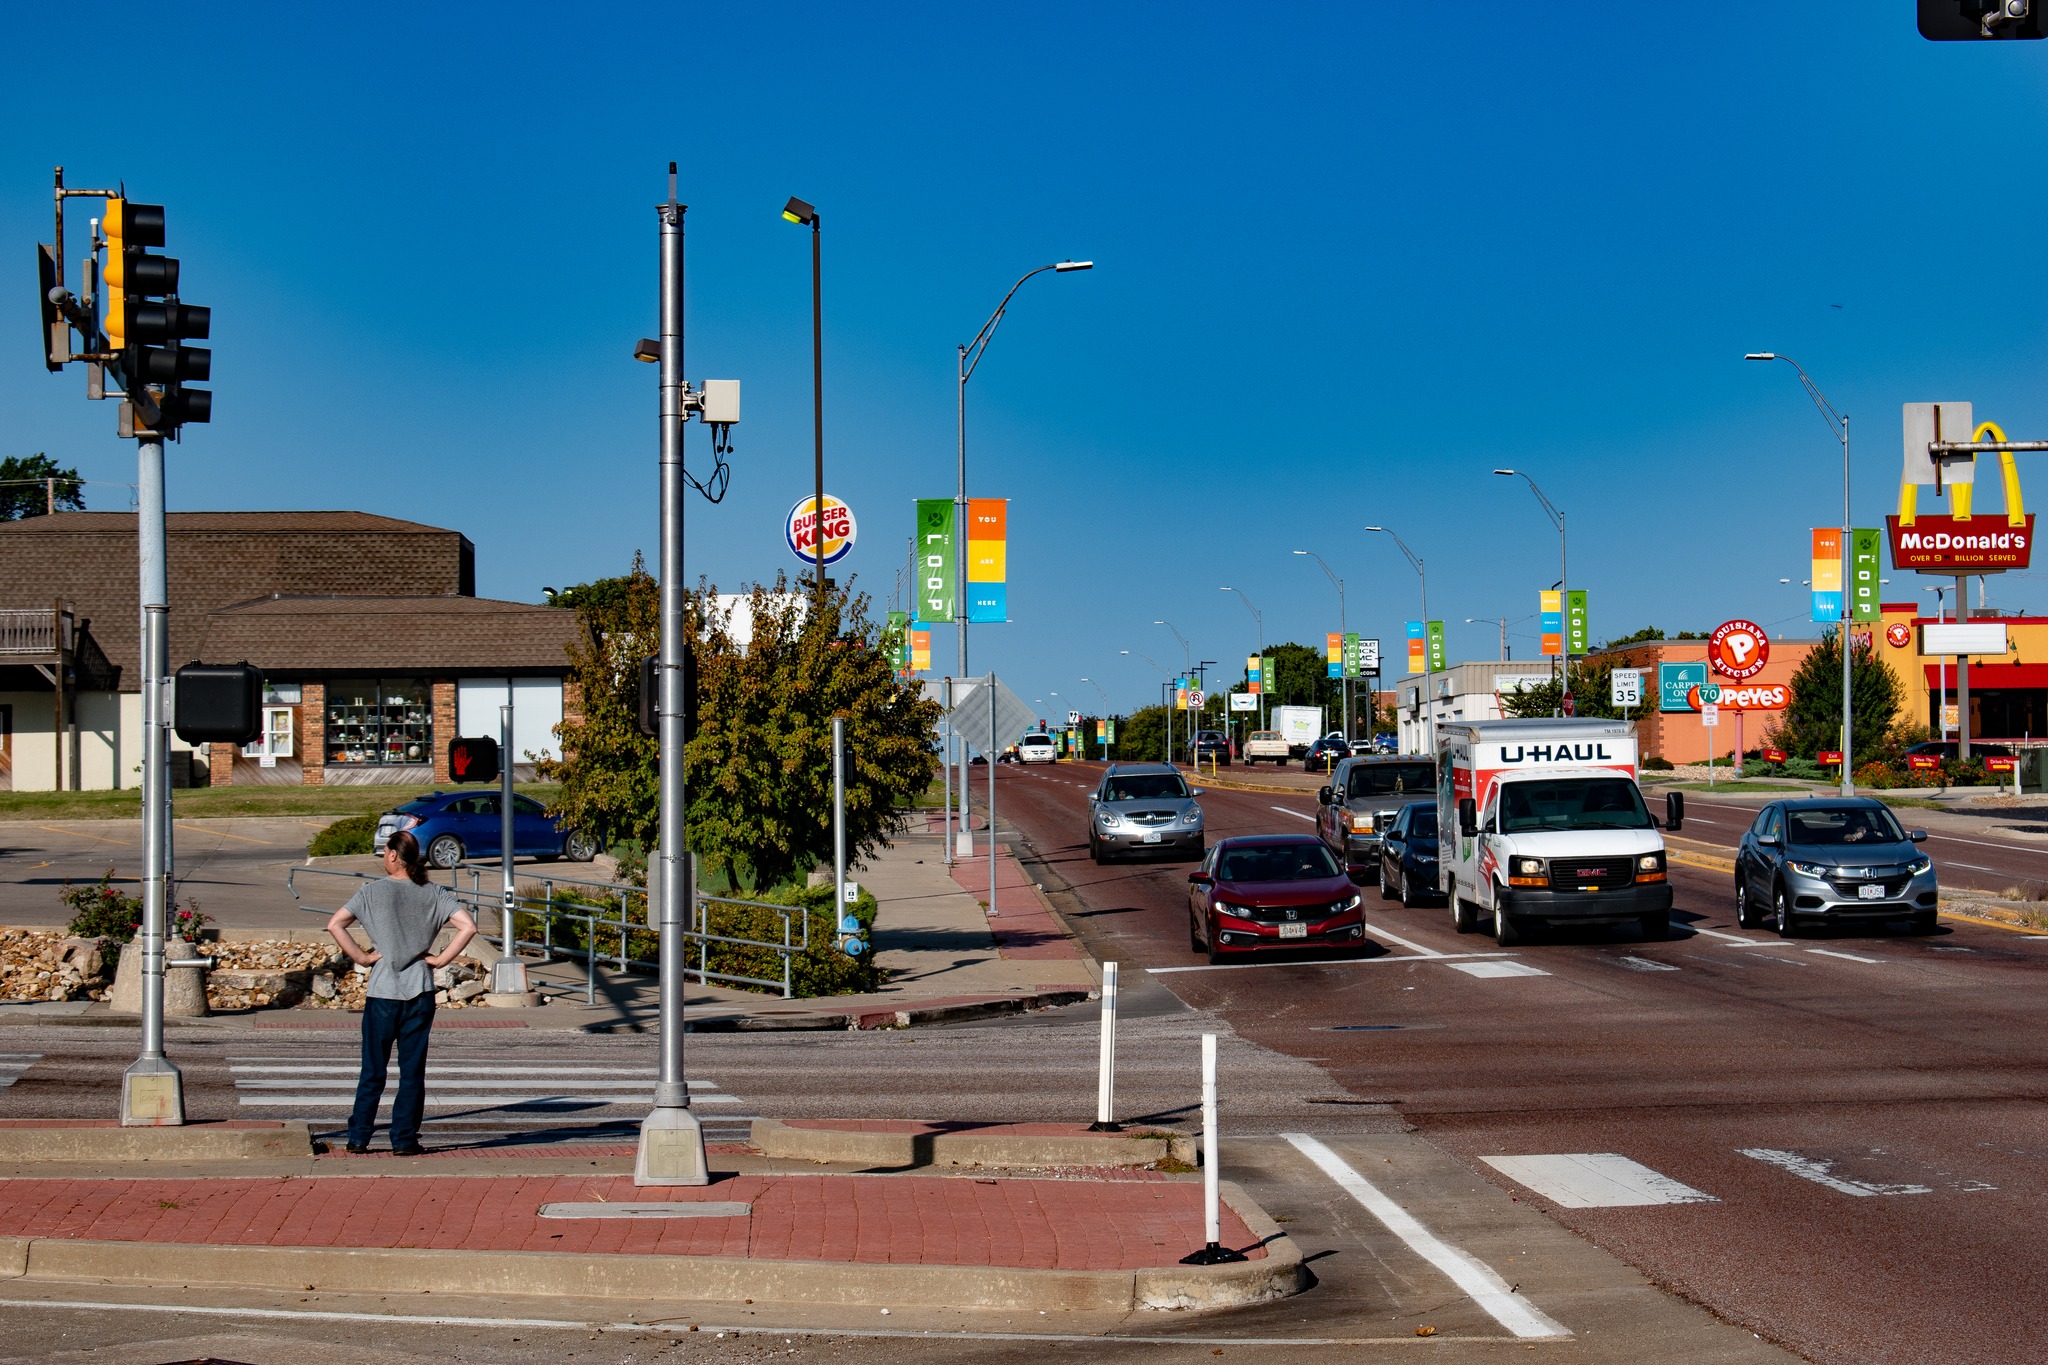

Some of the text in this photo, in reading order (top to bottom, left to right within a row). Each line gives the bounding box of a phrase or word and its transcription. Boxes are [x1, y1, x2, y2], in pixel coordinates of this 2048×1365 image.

[796, 519, 850, 551] KING
[1900, 533, 2026, 549] McDonald's
[927, 534, 943, 611] LOOP
[1858, 554, 1871, 613] LOOP
[1572, 608, 1582, 649] LOOP
[1713, 622, 1766, 647] LOUISIANA
[1432, 635, 1441, 668] LOOP
[1726, 634, 1755, 664] P
[1714, 657, 1764, 678] KITCHEN
[1616, 690, 1636, 702] 35
[1702, 690, 1717, 700] 70
[1501, 743, 1612, 763] U-HAUL
[1577, 868, 1607, 877] GMC
